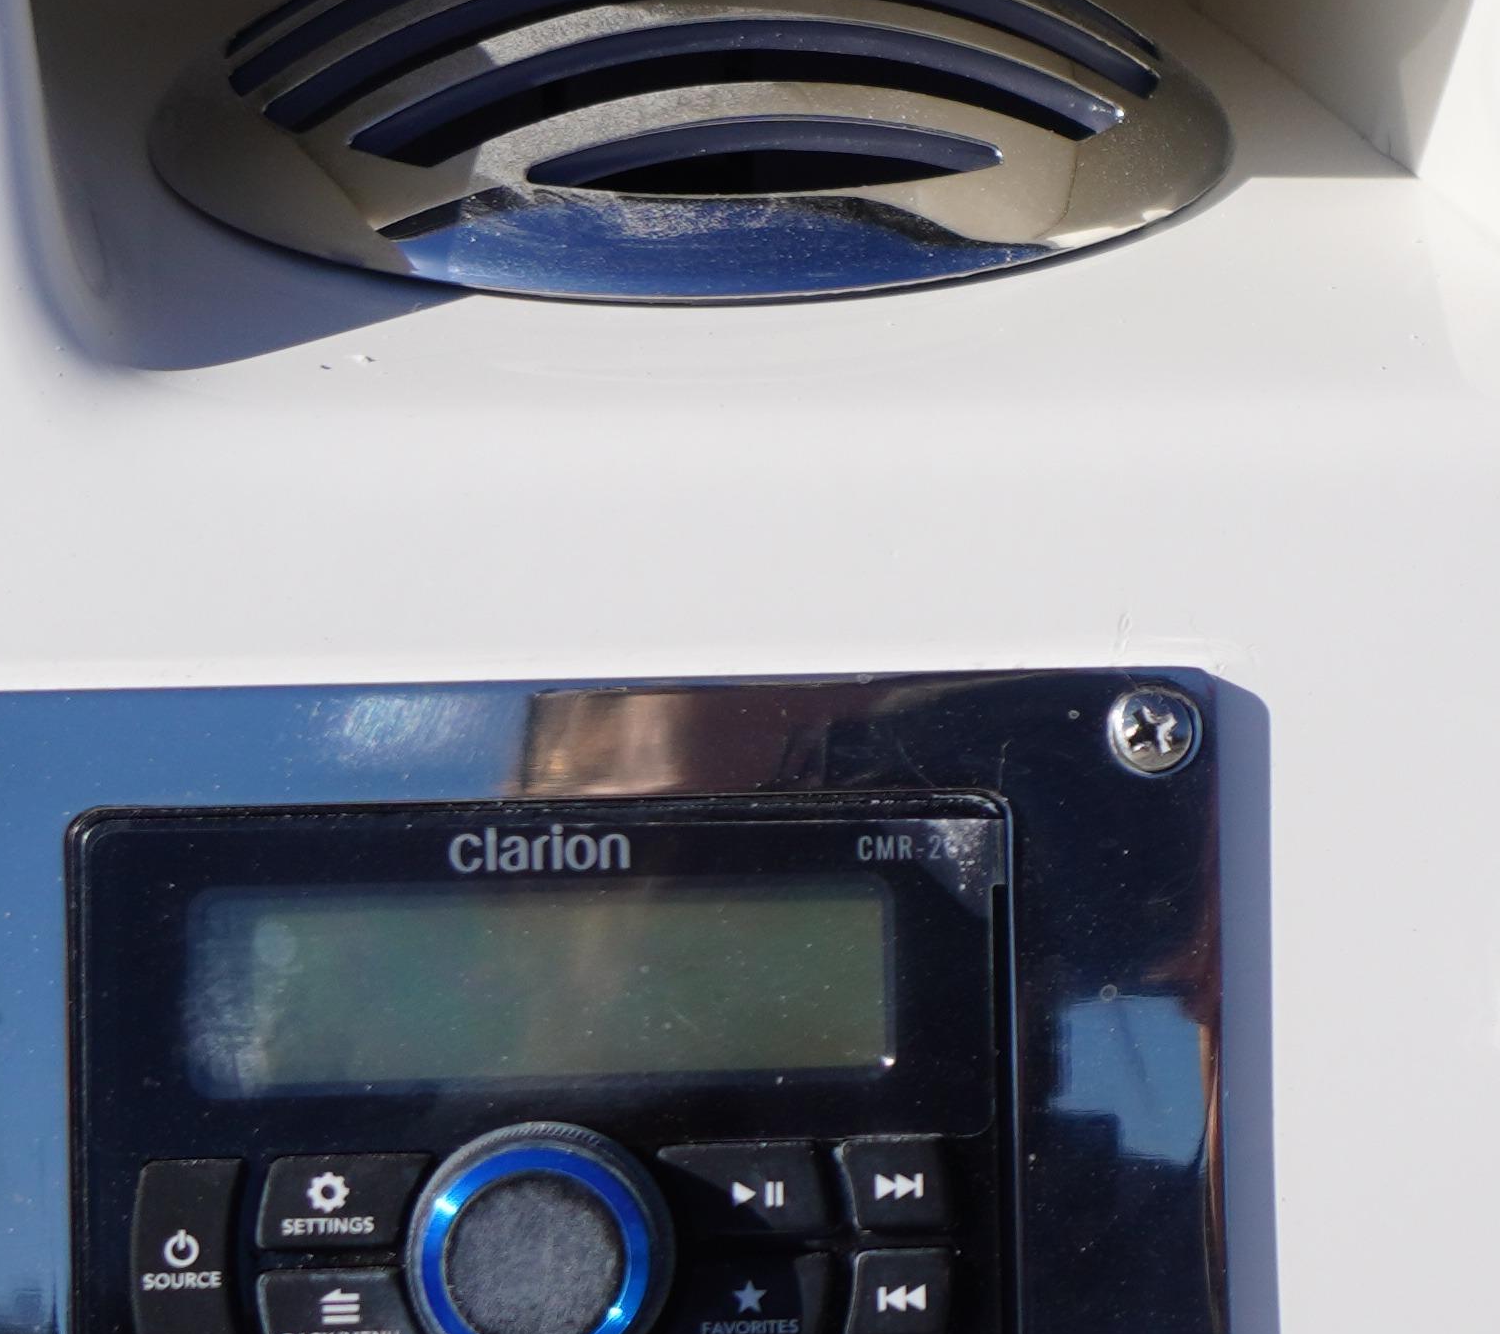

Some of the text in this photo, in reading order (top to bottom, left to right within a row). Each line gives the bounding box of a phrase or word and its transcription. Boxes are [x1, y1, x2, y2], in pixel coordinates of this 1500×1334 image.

[449, 824, 631, 873] clarion
[281, 1216, 375, 1236] SETTINGS
[142, 1271, 222, 1291] SOURCE
